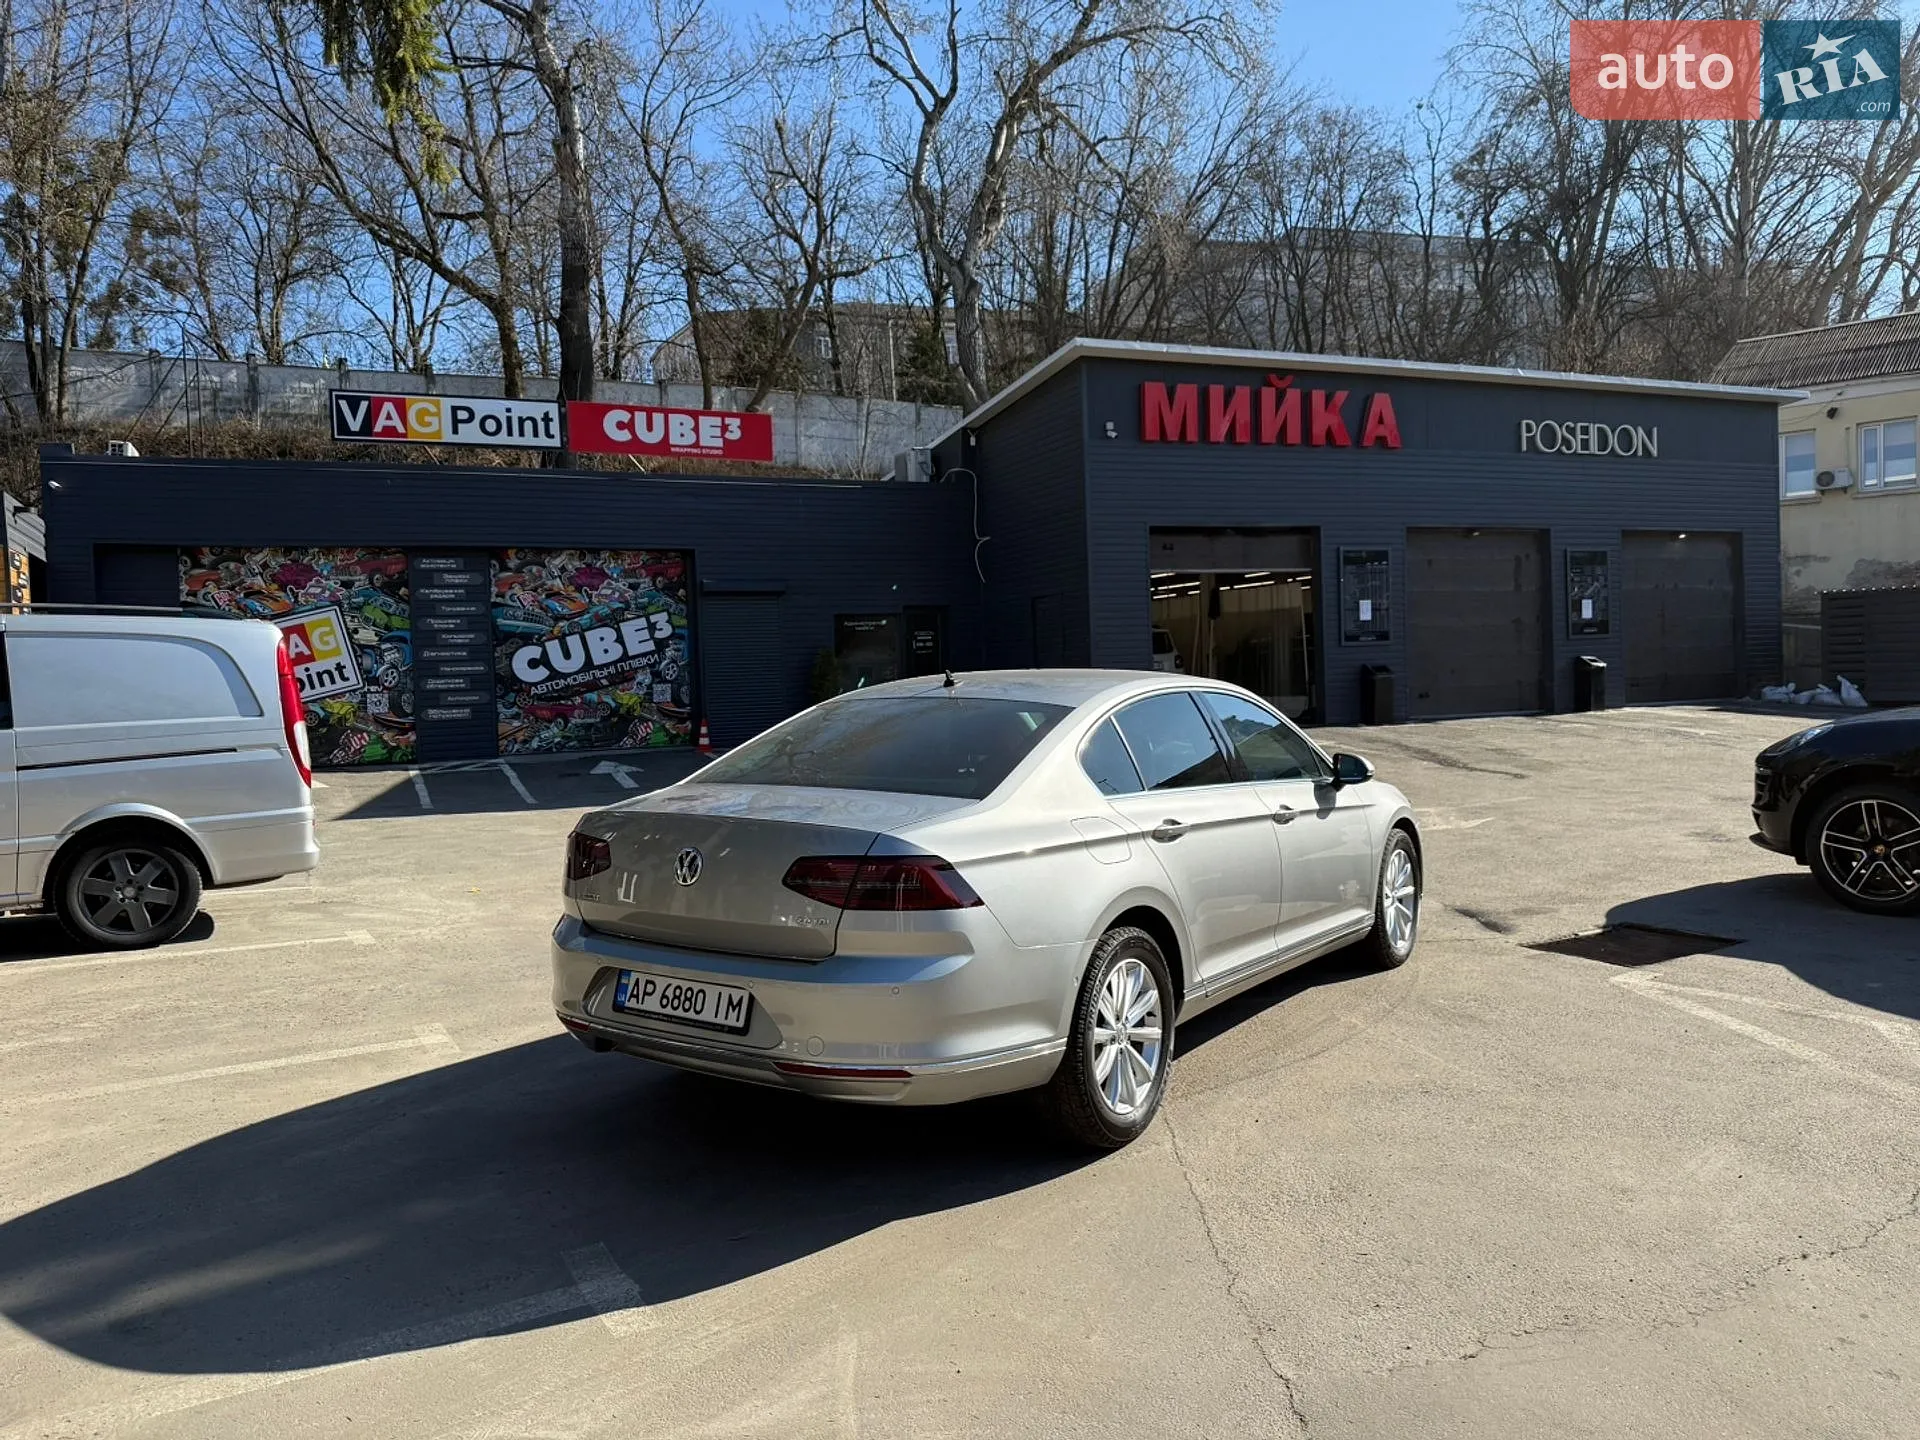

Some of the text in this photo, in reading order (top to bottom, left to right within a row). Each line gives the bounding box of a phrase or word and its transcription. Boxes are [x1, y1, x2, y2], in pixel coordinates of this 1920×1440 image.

[338, 398, 556, 440] VAG Point
[1140, 374, 1401, 449] МИЙКА
[1519, 418, 1659, 457] POSEIDON
[288, 626, 338, 659] AG
[627, 977, 744, 1022] AP 6880 IM
